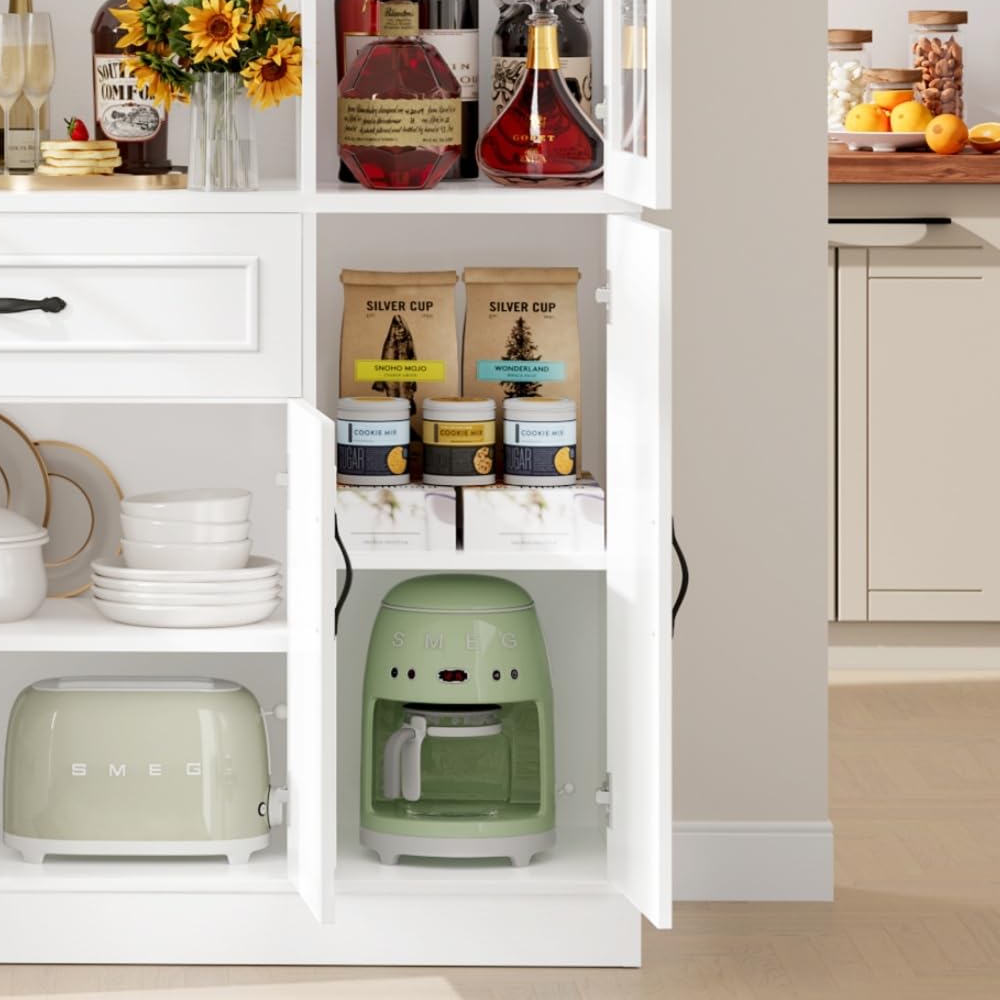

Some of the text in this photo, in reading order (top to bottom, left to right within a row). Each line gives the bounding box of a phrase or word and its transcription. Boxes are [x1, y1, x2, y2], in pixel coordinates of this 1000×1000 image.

[366, 300, 434, 311] SILVER CUP
[489, 301, 556, 313] SILVER CUP
[494, 365, 550, 373] WONDERLAND
[439, 429, 468, 437] COOKIE
[391, 631, 517, 650] SMEG
[72, 762, 201, 777] SMEG
